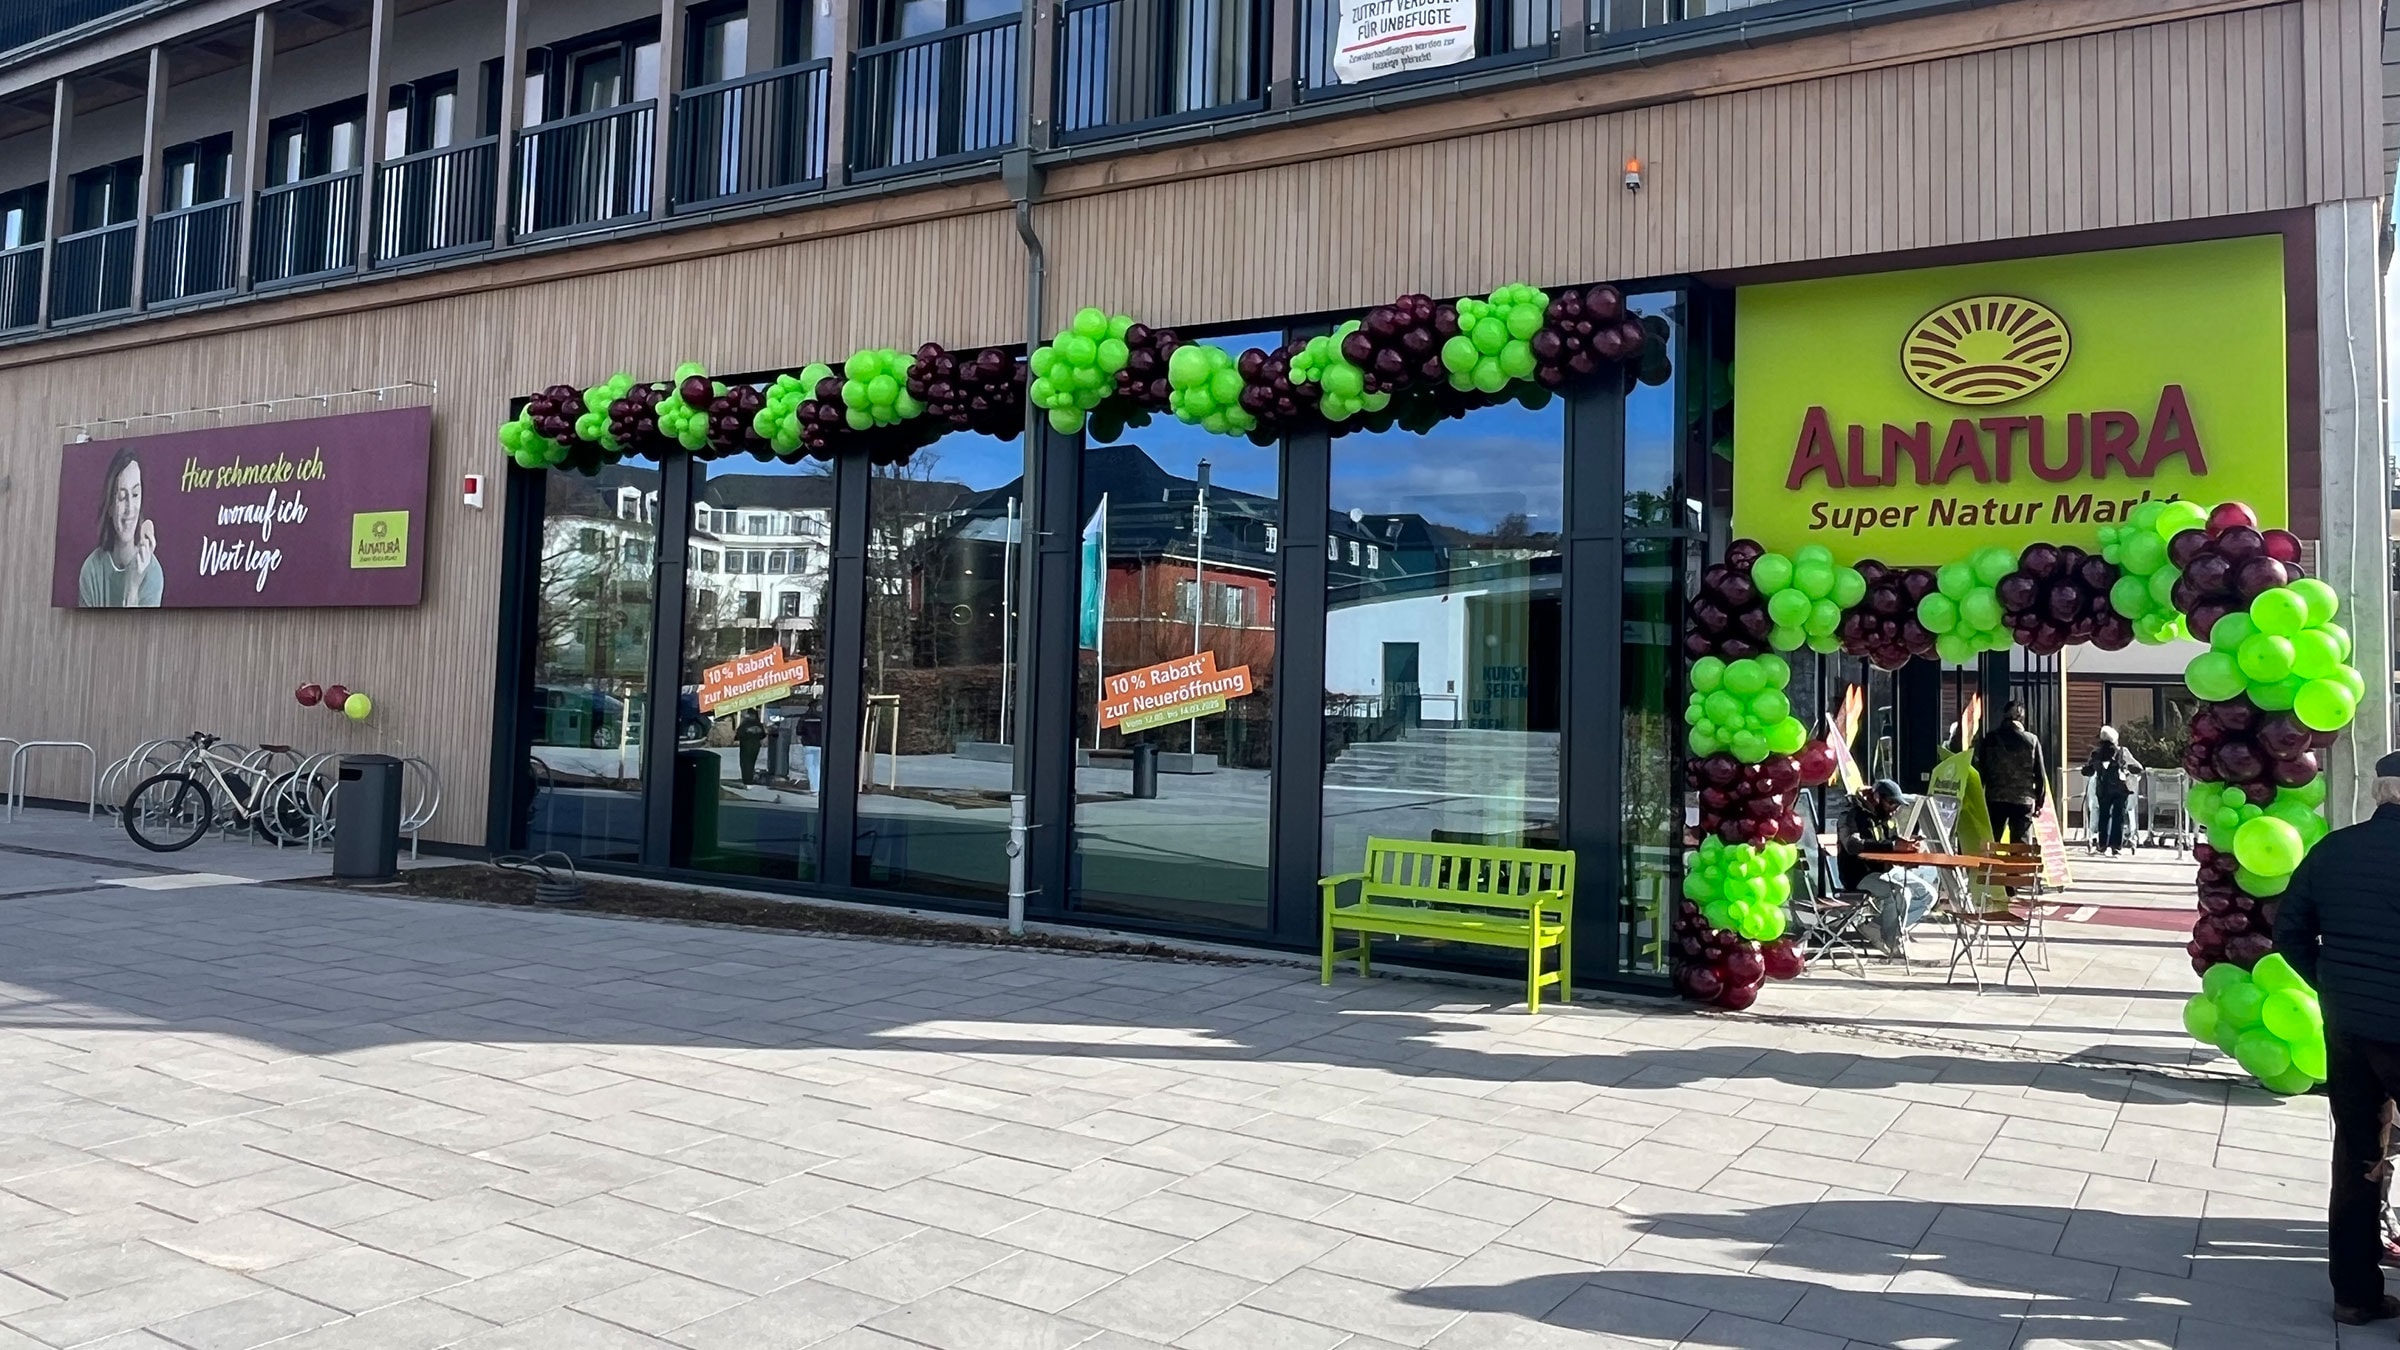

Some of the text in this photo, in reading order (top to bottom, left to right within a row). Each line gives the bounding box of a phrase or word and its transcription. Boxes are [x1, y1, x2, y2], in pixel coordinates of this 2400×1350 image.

[1352, 0, 1393, 24] ZUTRITT
[1358, 8, 1451, 41] FÜR UNBEFUGTE
[1785, 384, 2208, 490] ALNATURA
[181, 446, 326, 492] Hier schmecke ich,
[217, 488, 308, 542] worauf ich
[1808, 489, 2183, 536] Super Natur Mar
[200, 536, 283, 593] Wert lege
[704, 690, 721, 706] zur
[723, 665, 804, 698] Neueröffnung
[1105, 675, 1244, 719] zur Neueröffnung
